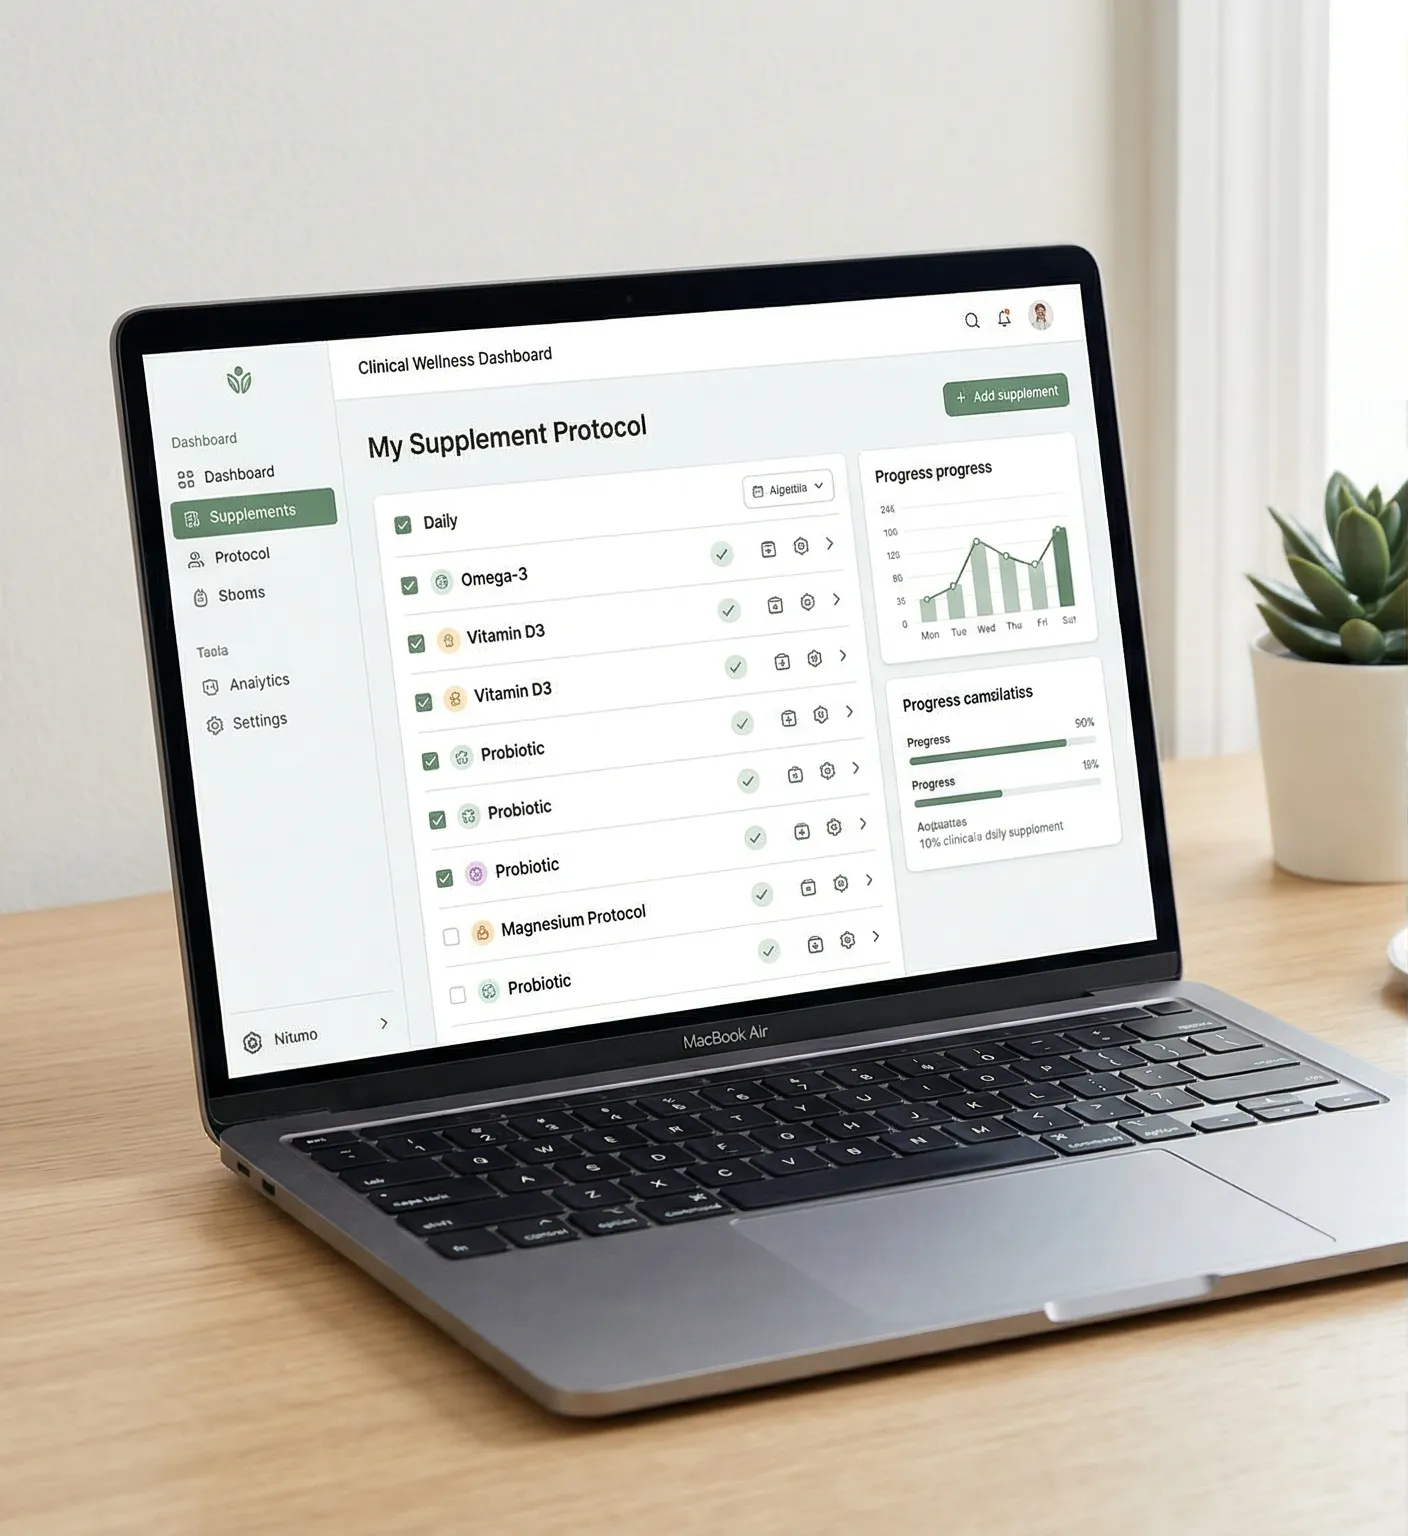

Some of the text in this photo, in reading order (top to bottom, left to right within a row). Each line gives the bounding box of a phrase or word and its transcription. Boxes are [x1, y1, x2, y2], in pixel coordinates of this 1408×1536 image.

[359, 346, 552, 374] Clinical Wellness Dashboard
[974, 390, 994, 402] Add
[172, 432, 237, 448] Dashboard
[368, 414, 646, 462] My Supplement Protocol
[205, 465, 274, 483] Dashboard
[875, 463, 992, 484] Progress progress
[210, 505, 296, 524] Supplements
[424, 513, 457, 530] Daily
[216, 547, 270, 563] Protocol
[462, 567, 527, 587] Omega-3
[219, 589, 265, 601] Sboms
[467, 624, 545, 644] Vitamin D3
[922, 631, 939, 639] Mon
[951, 628, 966, 636] Tue
[978, 624, 995, 633] Wed
[1038, 618, 1047, 626] Fri
[474, 681, 551, 702] Vitamin D3
[903, 696, 960, 712] Progress
[234, 714, 287, 729] Settings
[481, 741, 544, 761] Probiotic
[912, 778, 955, 791] Progress
[488, 799, 551, 819] Probiotic
[920, 838, 941, 848] 10%
[496, 857, 559, 878] Probiotic
[502, 904, 646, 937] Magnesium Protocol
[509, 974, 571, 995] Probiotic
[684, 1025, 768, 1049] MacBook Air
